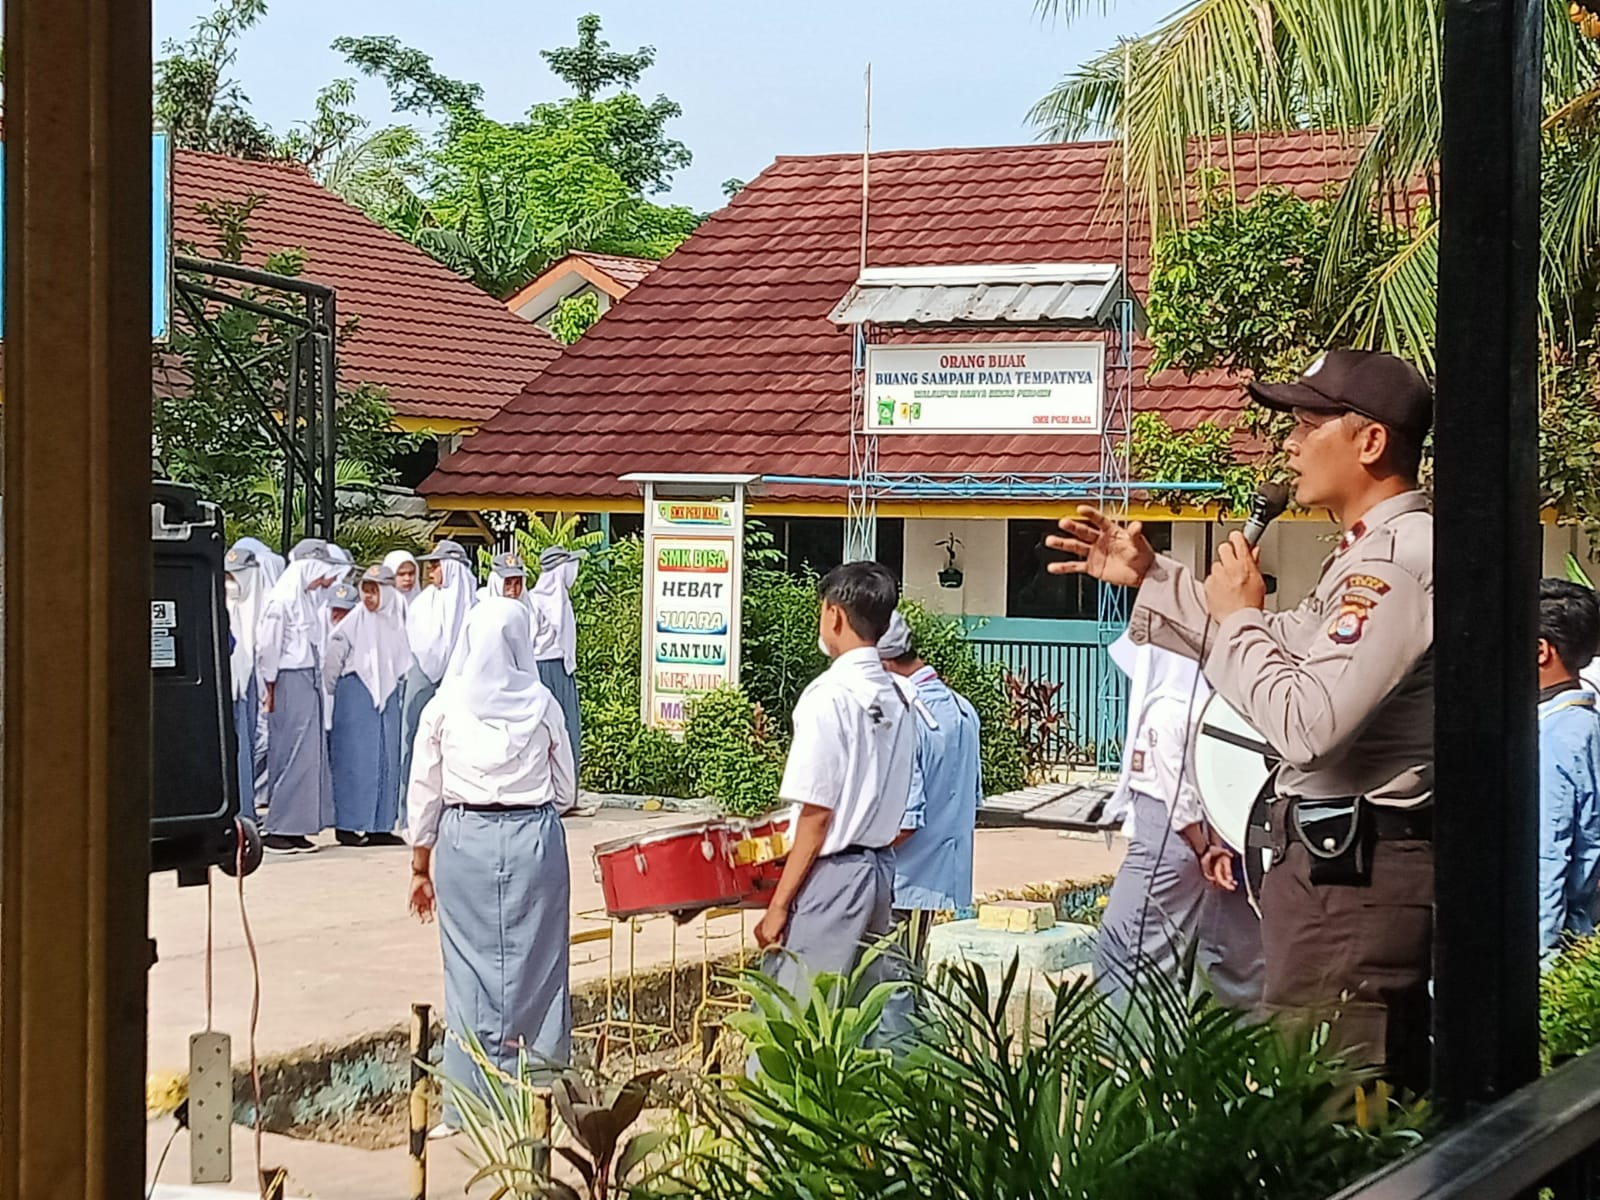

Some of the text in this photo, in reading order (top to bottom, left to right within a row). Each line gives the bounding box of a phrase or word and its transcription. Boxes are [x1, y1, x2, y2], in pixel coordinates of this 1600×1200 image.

[940, 355, 985, 369] ORANG
[875, 370, 1093, 385] BUANG SAMPAH PADA TEMPATNYA
[659, 548, 727, 568] SMK BISA
[662, 581, 723, 599] HEBAT
[659, 610, 723, 630] JUARA
[660, 643, 722, 659] SANTUN
[660, 671, 722, 690] KREATIF
